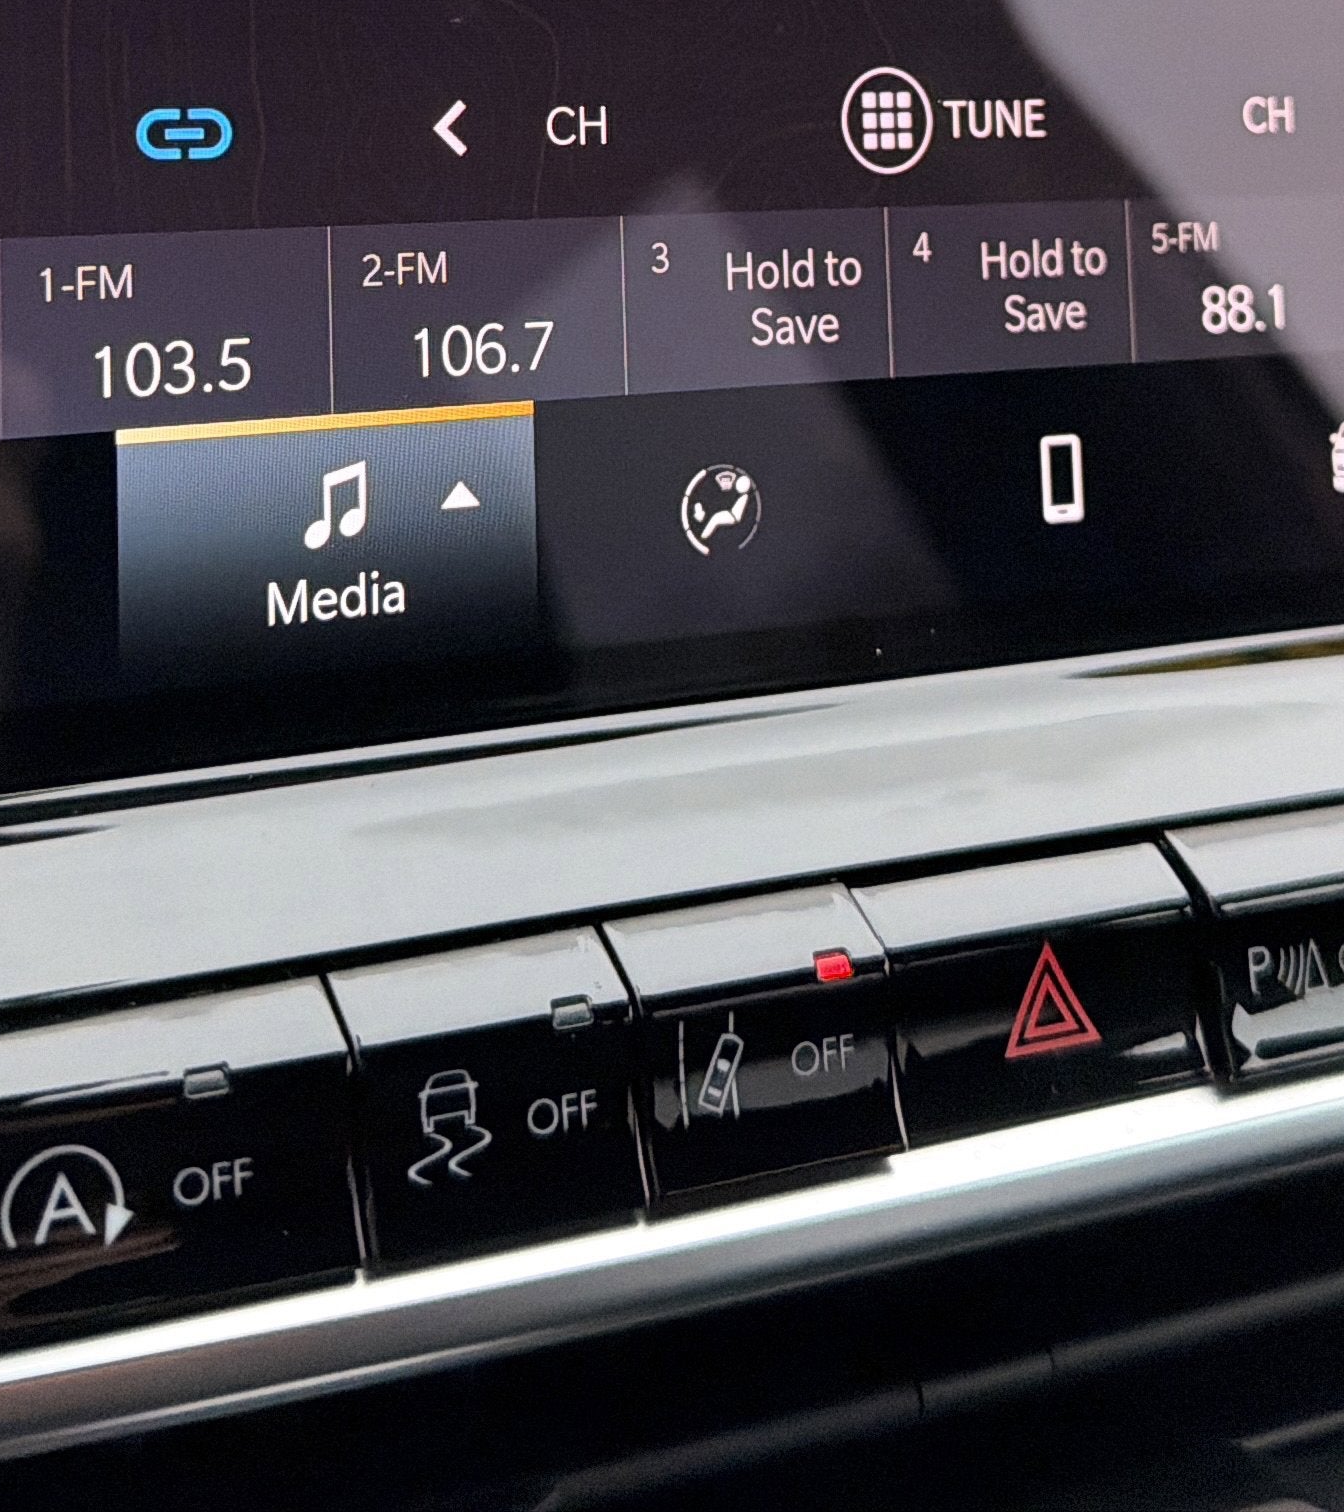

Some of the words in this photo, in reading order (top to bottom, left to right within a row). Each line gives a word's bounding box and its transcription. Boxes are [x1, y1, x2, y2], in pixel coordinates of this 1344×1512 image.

[545, 105, 608, 146] CH
[943, 98, 1047, 139] TUNE
[1241, 96, 1294, 133] CH
[650, 243, 670, 274] 3
[911, 233, 932, 263] 4
[980, 238, 1064, 280] Hold
[1068, 240, 1108, 275] to
[1150, 221, 1219, 256] 5-FM
[40, 265, 134, 303] 1-FM
[361, 251, 448, 288] 2-FM
[725, 247, 816, 291] Hold
[823, 252, 863, 286] to
[750, 309, 840, 348] Save
[1004, 296, 1087, 333] Save
[1201, 284, 1287, 334] 88.1
[94, 337, 253, 400] 103.5
[413, 321, 554, 378] 106.7
[266, 571, 406, 626] Media
[791, 1033, 854, 1076] OFF
[527, 1088, 597, 1135] OFF
[174, 1157, 254, 1206] OFF
